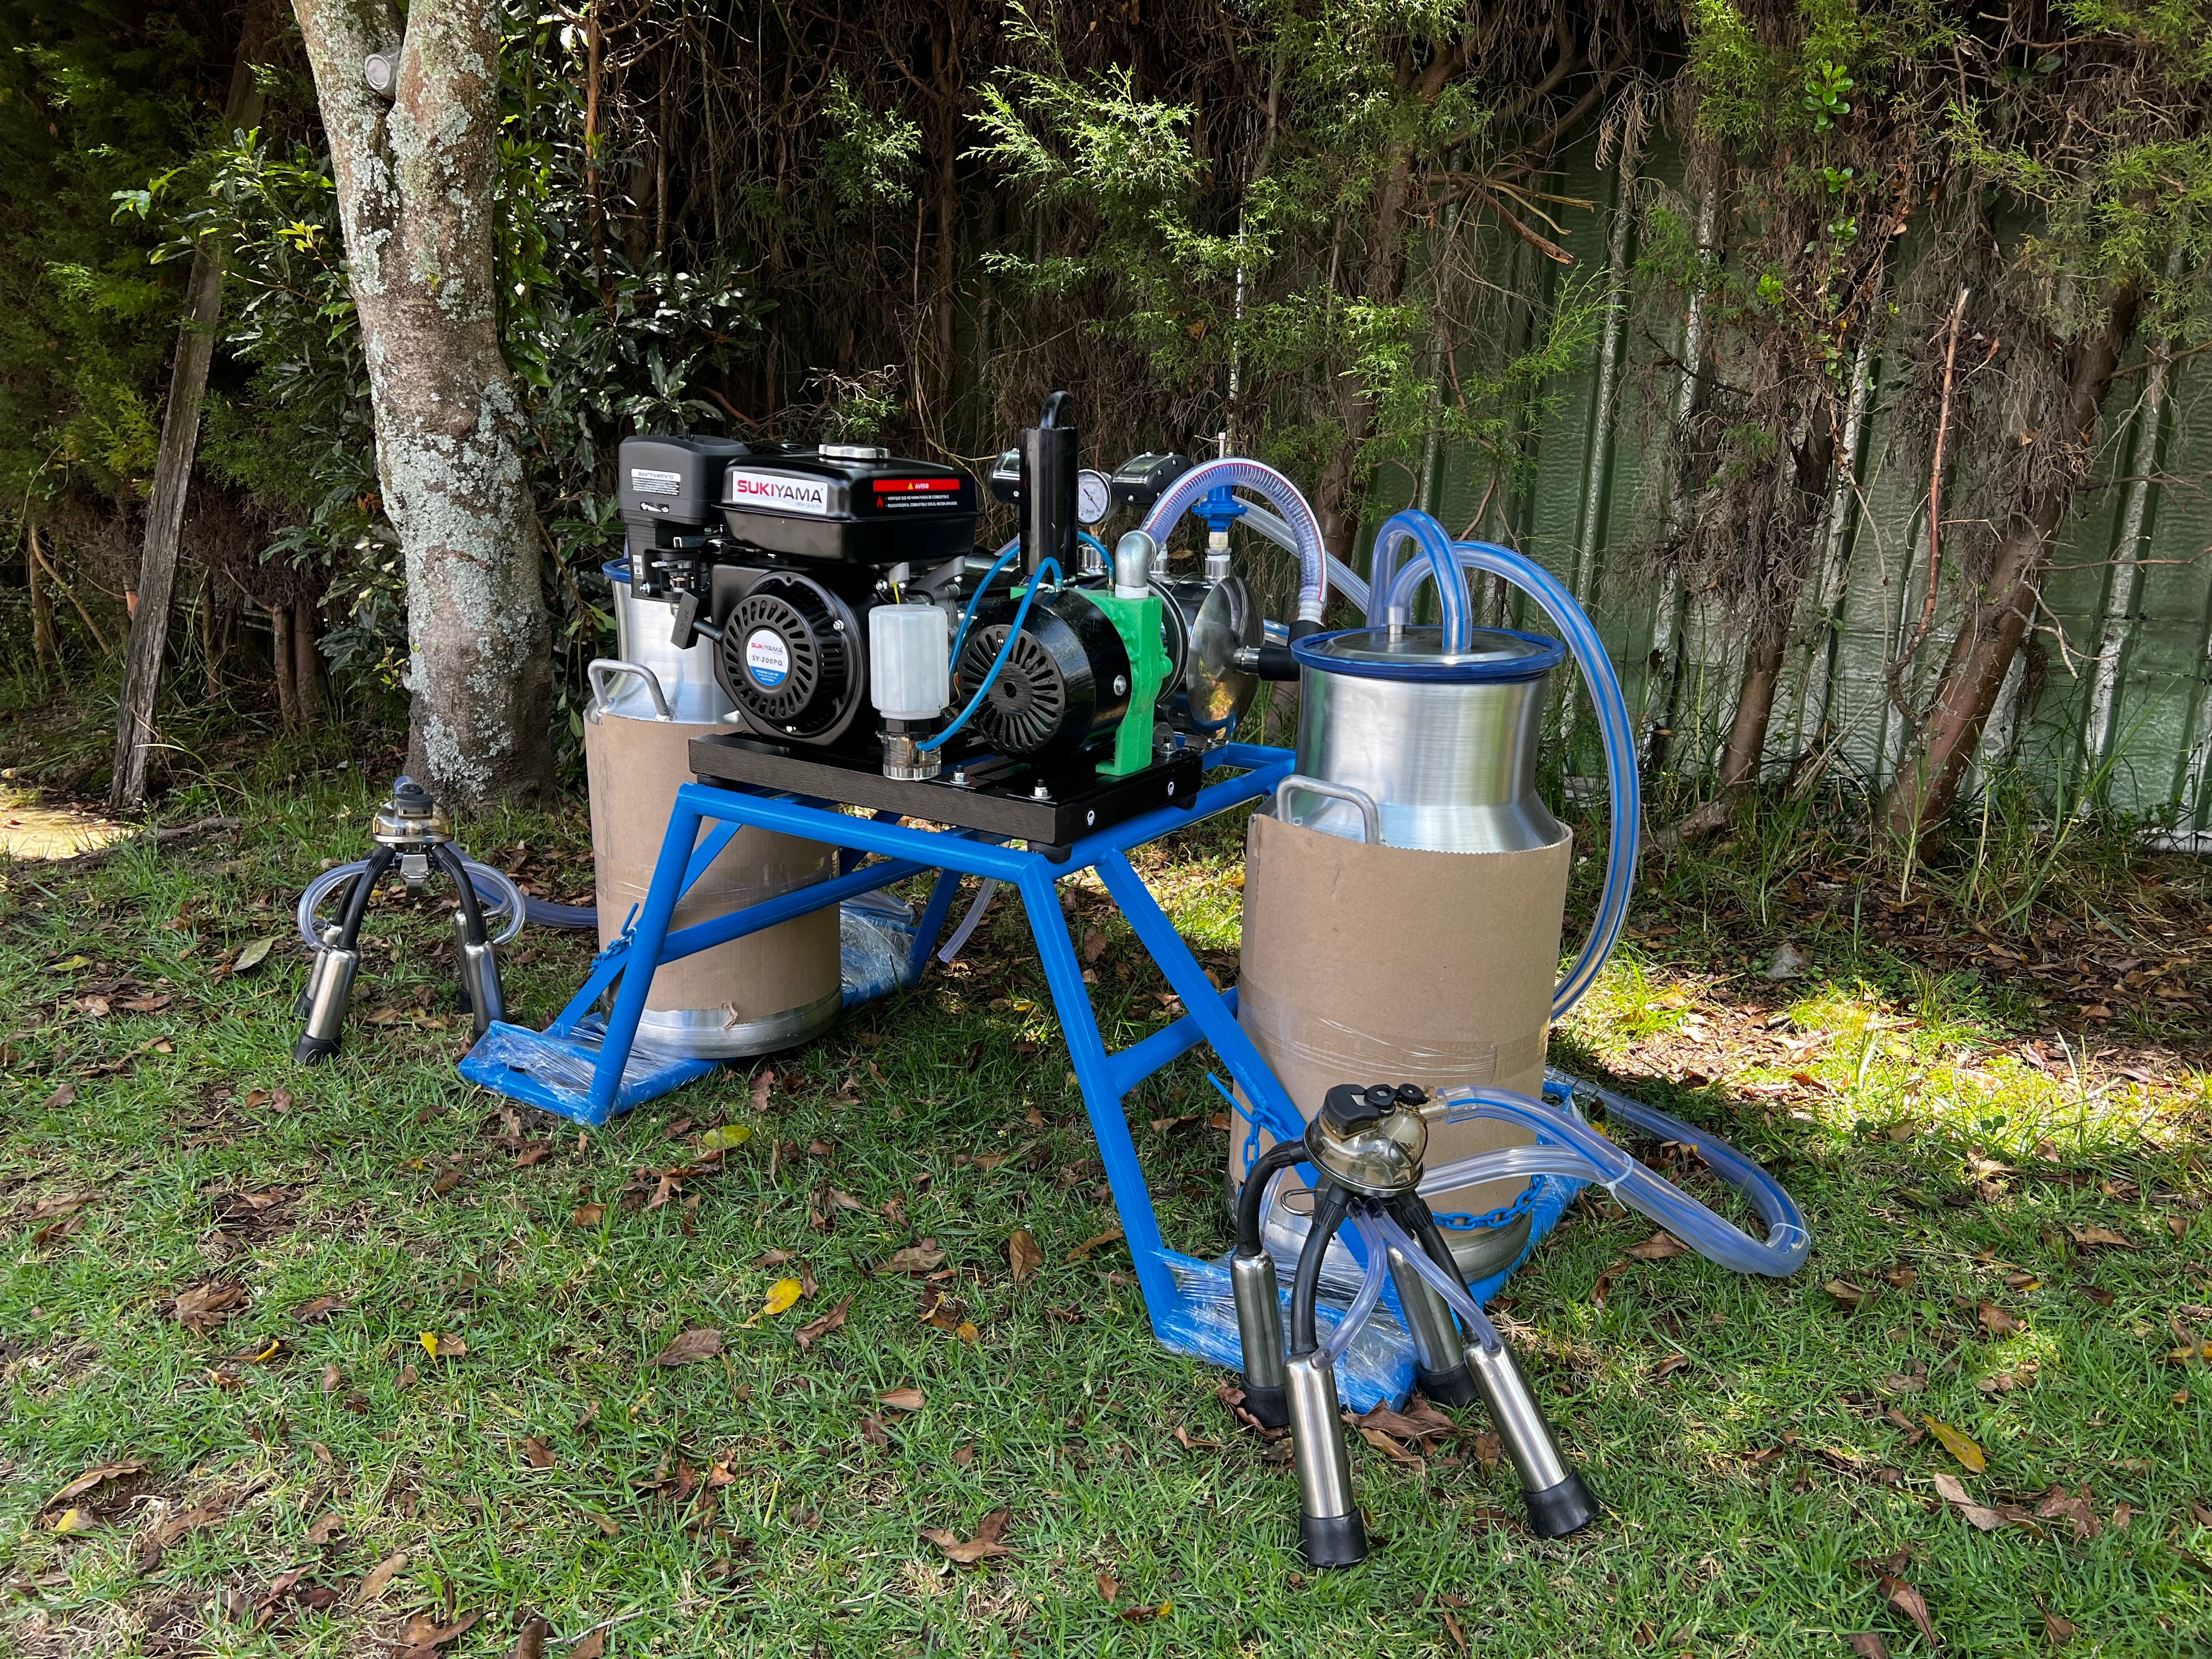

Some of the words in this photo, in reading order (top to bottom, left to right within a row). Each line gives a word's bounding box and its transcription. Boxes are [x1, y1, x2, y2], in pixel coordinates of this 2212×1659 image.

[737, 480, 822, 503] SUKIYAMA
[751, 643, 783, 653] SUKIYAMA
[752, 656, 782, 666] SY-200PQ
